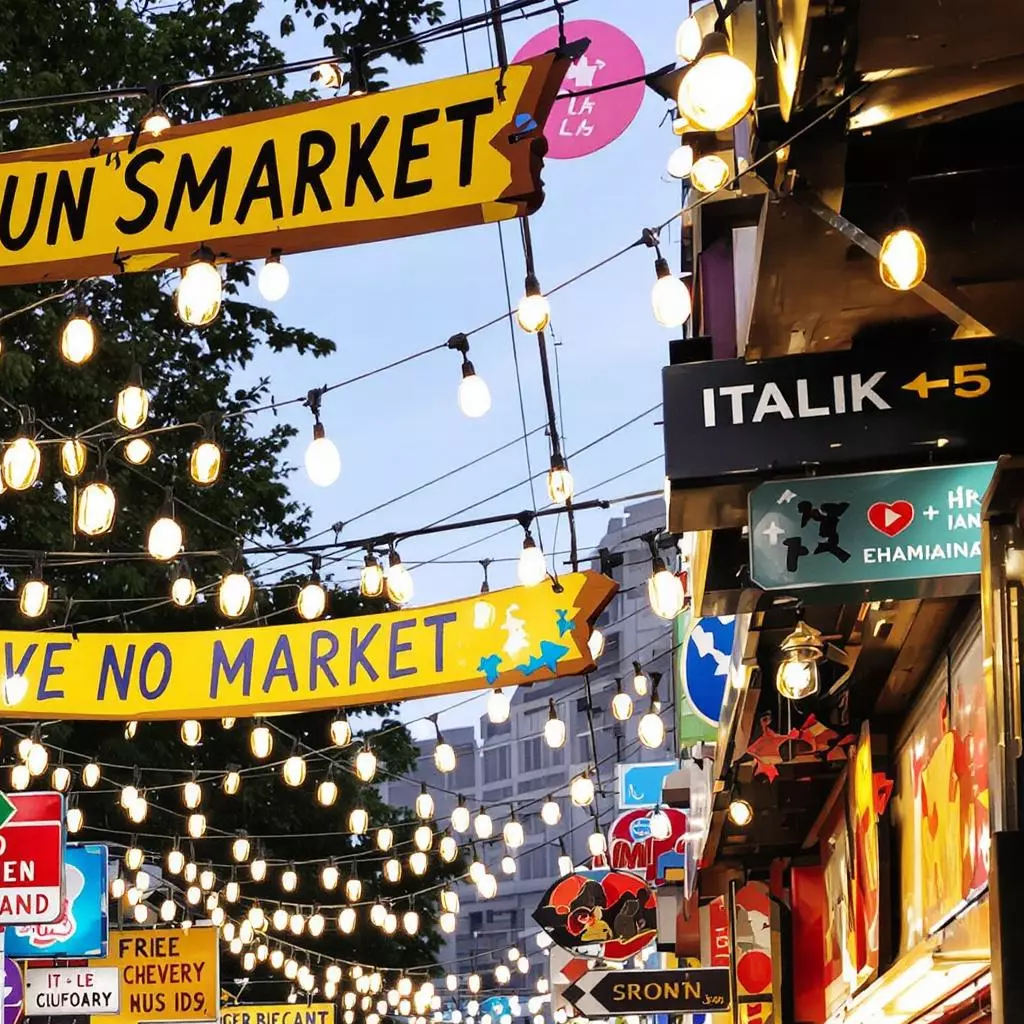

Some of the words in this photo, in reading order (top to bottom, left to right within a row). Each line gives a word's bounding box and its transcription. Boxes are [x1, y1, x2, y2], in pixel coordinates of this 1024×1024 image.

[702, 371, 891, 428] ITALIK
[954, 363, 991, 398] 5
[98, 643, 173, 701] NO
[210, 611, 457, 699] MARKET
[119, 937, 180, 958] FRIEE
[124, 962, 206, 985] CHEVERY
